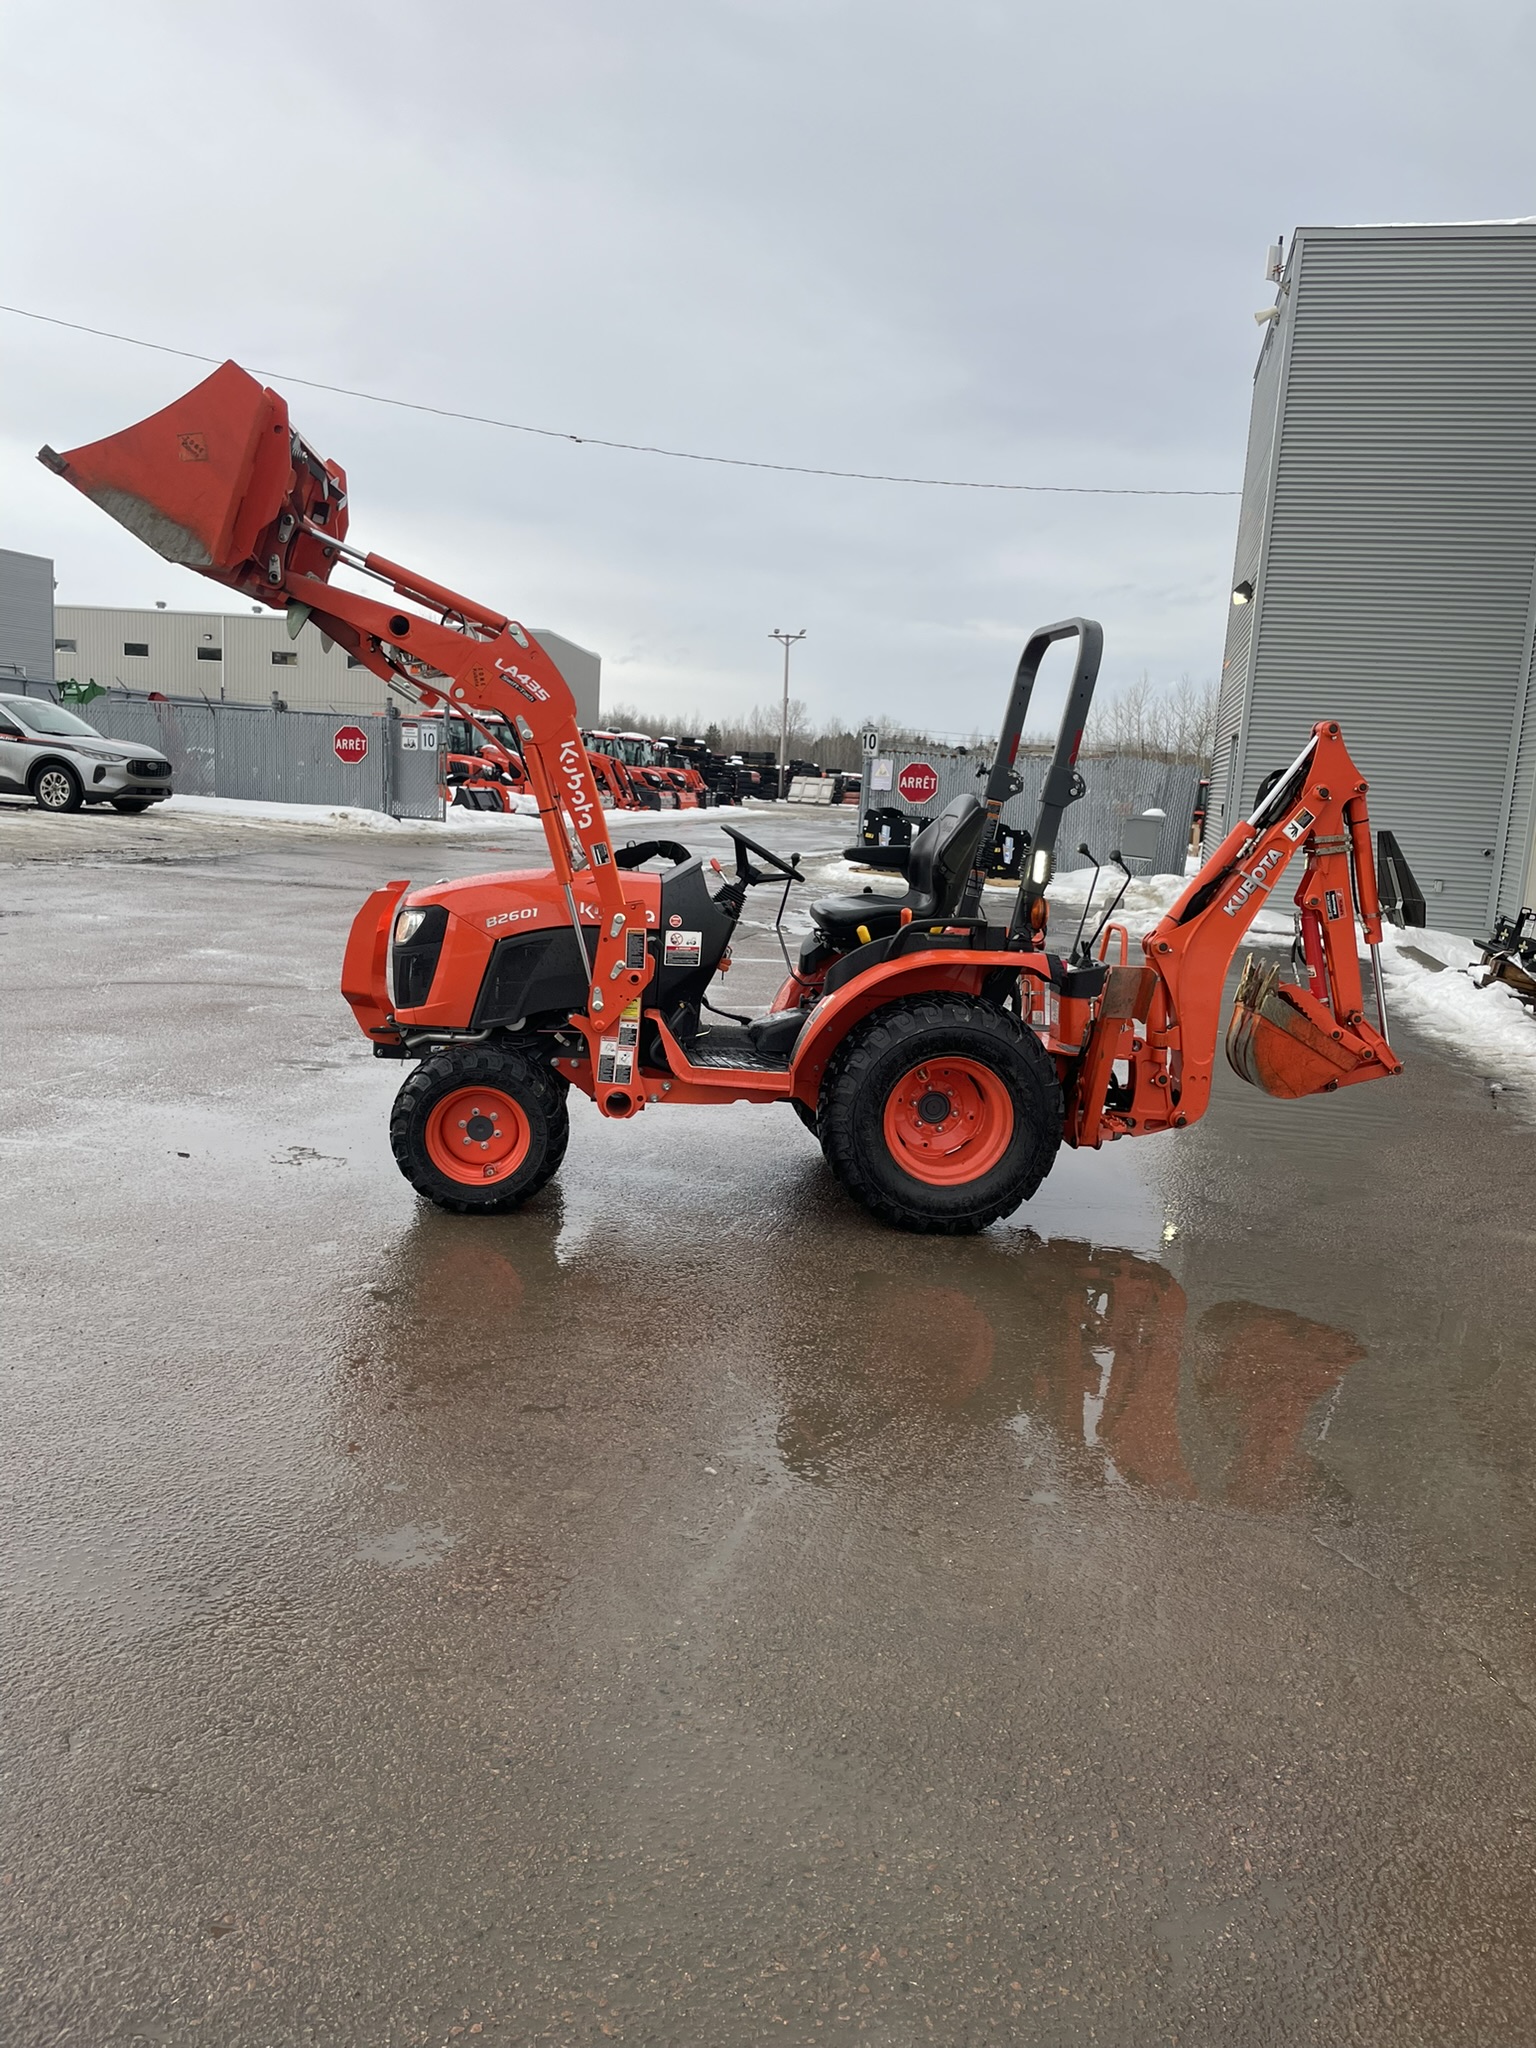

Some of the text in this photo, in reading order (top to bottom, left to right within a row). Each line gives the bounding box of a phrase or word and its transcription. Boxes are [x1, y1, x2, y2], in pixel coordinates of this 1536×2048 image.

[495, 658, 551, 702] LA435
[336, 738, 367, 751] ARRÊT
[423, 733, 435, 748] 10
[863, 733, 877, 750] 10
[560, 740, 593, 829] Kubota
[900, 776, 937, 790] ARRÊT
[1222, 849, 1284, 917] KUBOTA
[486, 907, 538, 928] B2601
